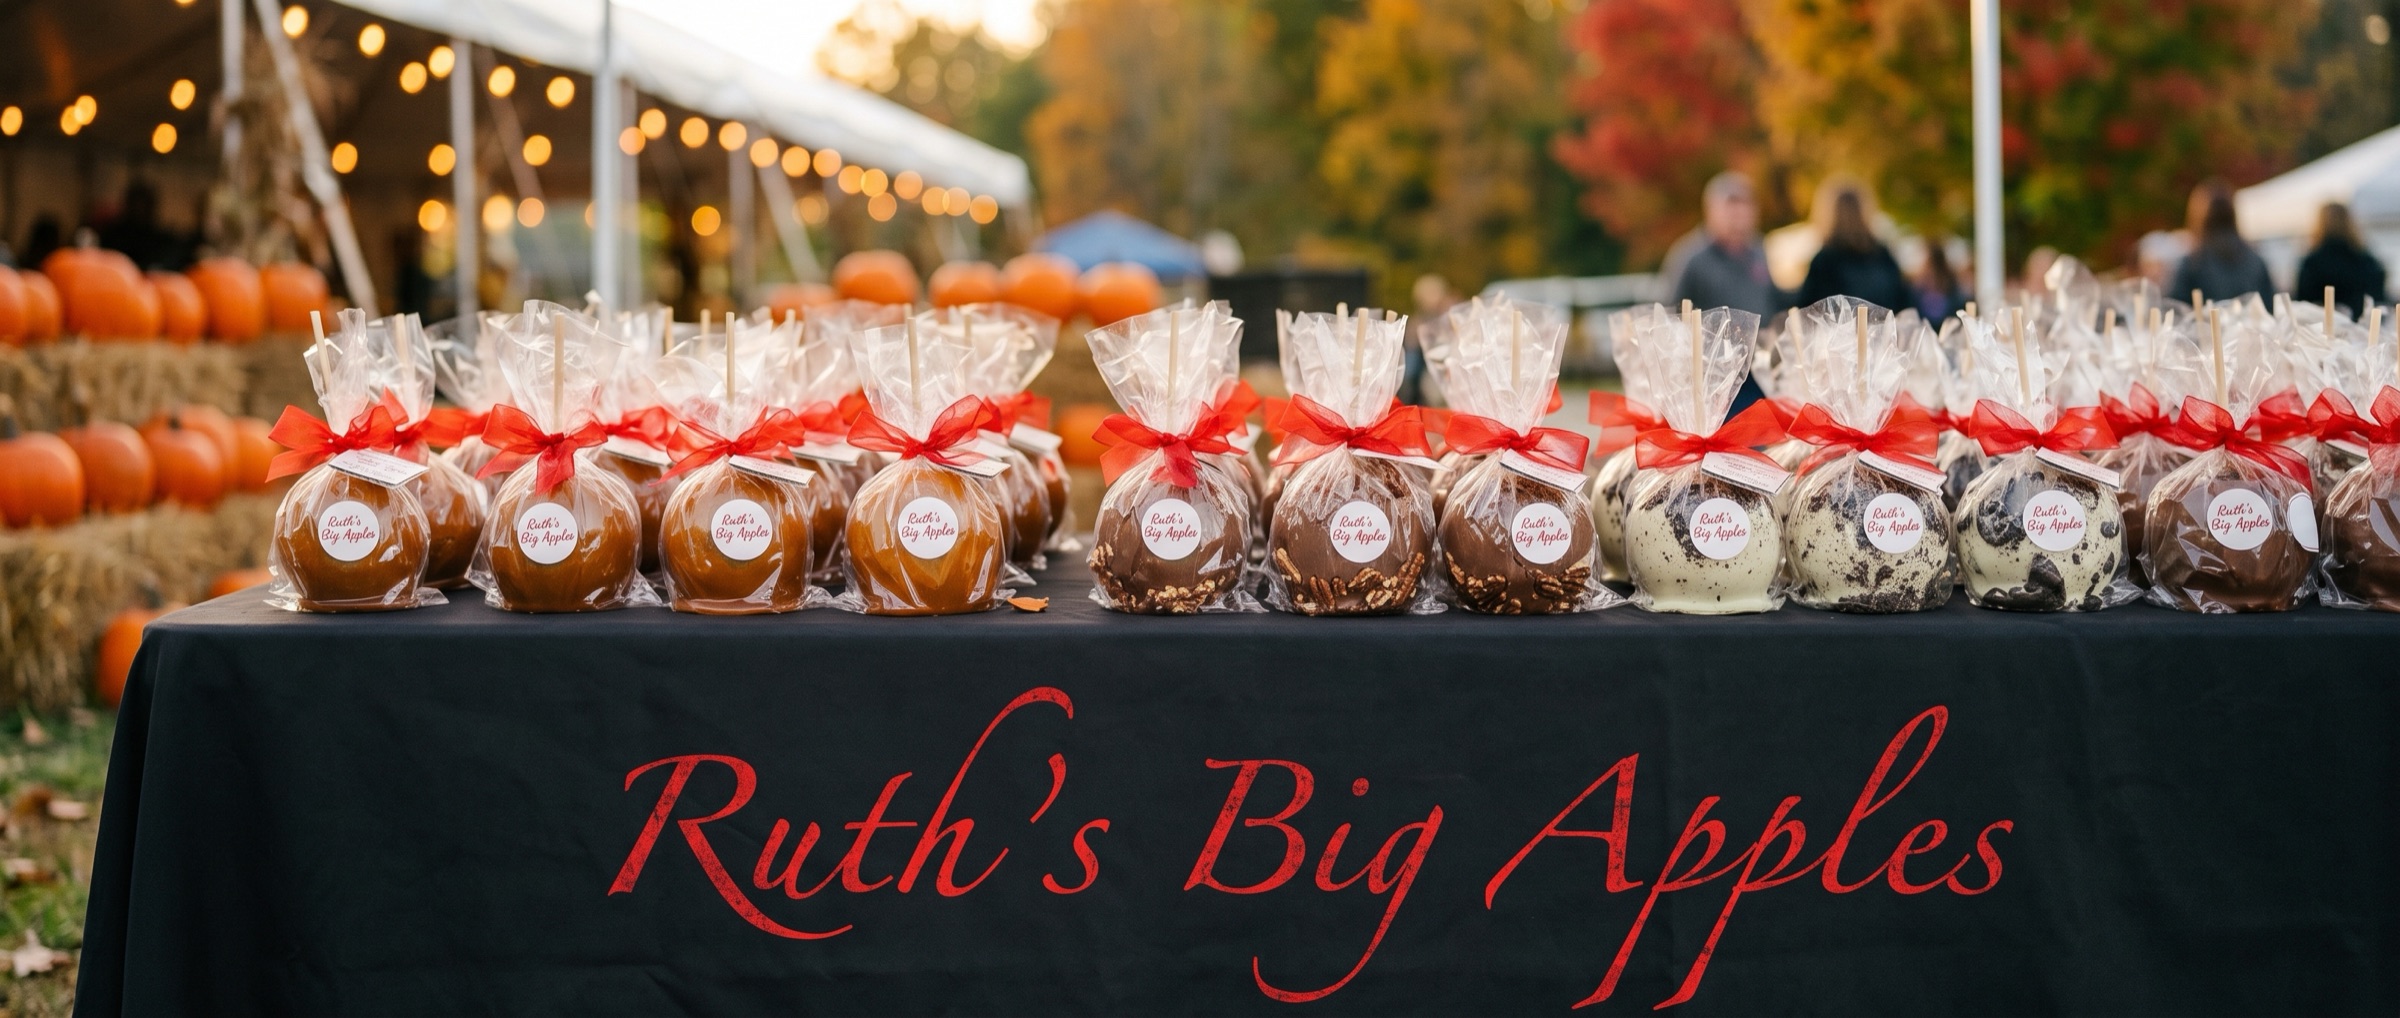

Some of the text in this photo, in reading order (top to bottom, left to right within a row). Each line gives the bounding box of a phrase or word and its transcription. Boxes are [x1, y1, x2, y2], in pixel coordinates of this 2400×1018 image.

[1699, 511, 1732, 524] Ruth's
[1872, 507, 1905, 519] Ruth's
[2033, 505, 2067, 517] Ruth's
[2216, 503, 2253, 517] Ruth's
[328, 515, 361, 527] Ruth's
[527, 517, 560, 530] Ruth's
[722, 513, 755, 526] Ruth's
[908, 512, 941, 525] Ruth's
[1150, 513, 1184, 525] Ruth's
[1339, 516, 1372, 528] Ruth's
[1521, 517, 1554, 529] Ruth's
[2028, 516, 2082, 534] Big Apples
[2210, 514, 2270, 534] Big Apples
[715, 525, 770, 545] Big Apples
[902, 522, 955, 542] Big Apples
[1145, 526, 1162, 543] Big
[1693, 524, 1746, 542] Big Apples
[1867, 518, 1920, 537] Big Apples
[521, 531, 539, 548] Big
[1333, 528, 1351, 546] Big
[1515, 529, 1534, 547] Big
[607, 687, 2014, 1010] Ruth's Big Apples
